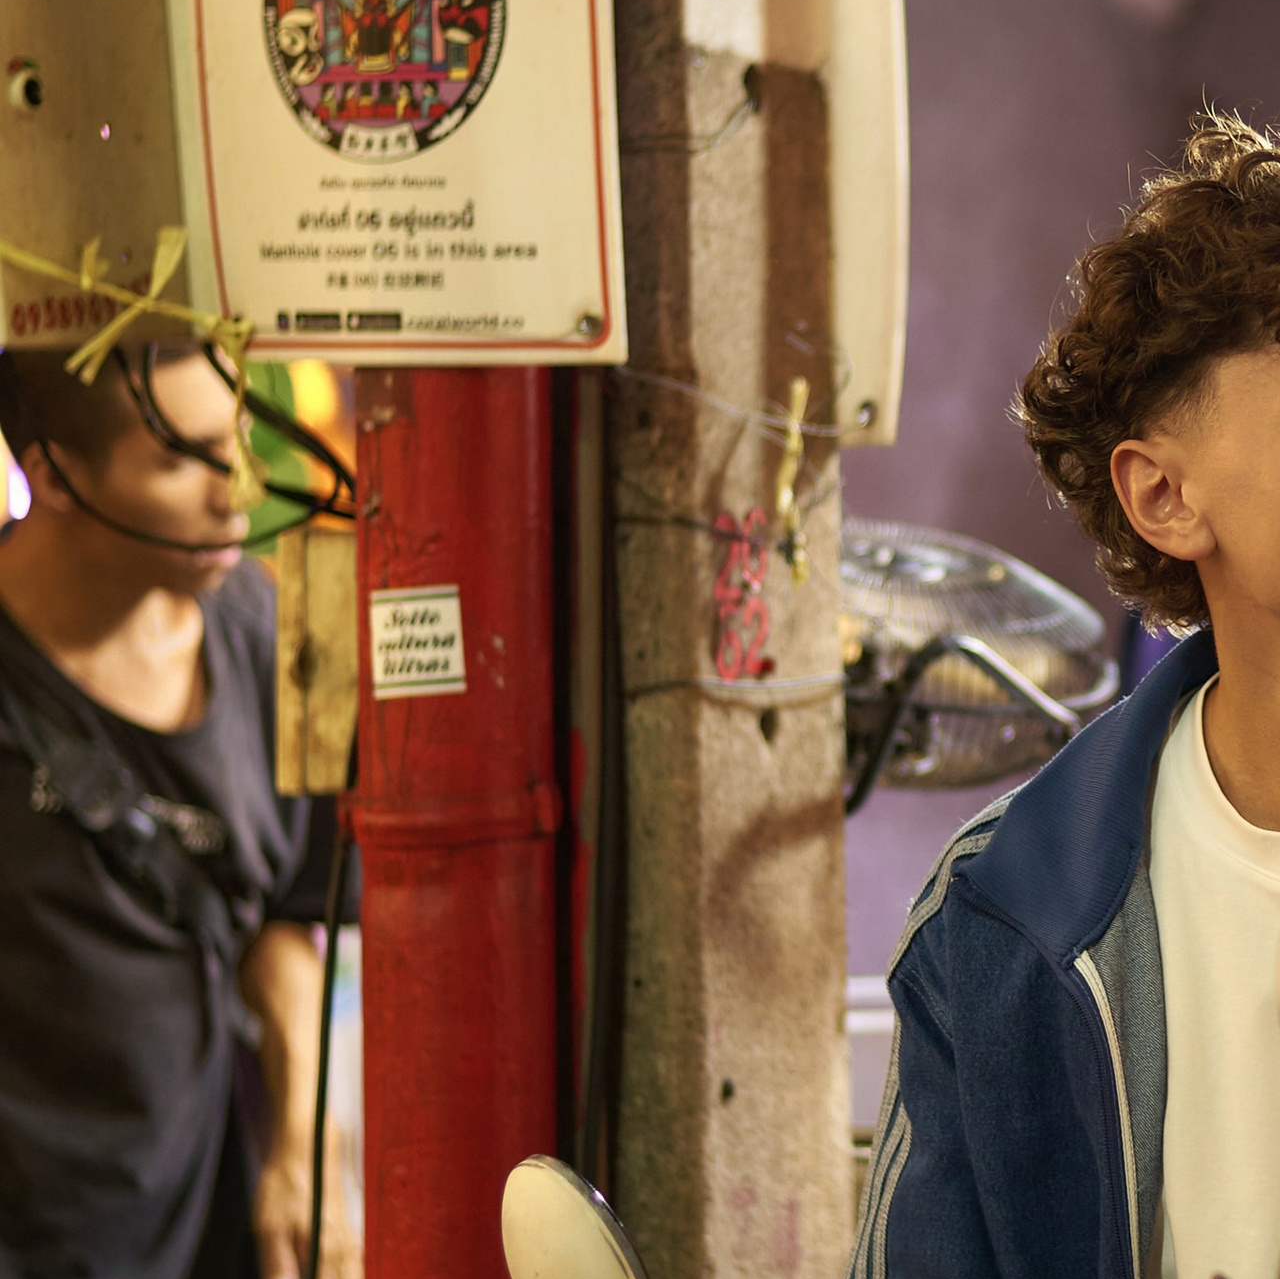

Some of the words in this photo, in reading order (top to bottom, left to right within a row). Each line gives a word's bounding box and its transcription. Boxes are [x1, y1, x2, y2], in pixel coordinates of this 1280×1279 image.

[372, 241, 399, 259] 06
[404, 241, 419, 259] is
[426, 241, 444, 258] in
[450, 241, 486, 258] this
[494, 241, 538, 259] area
